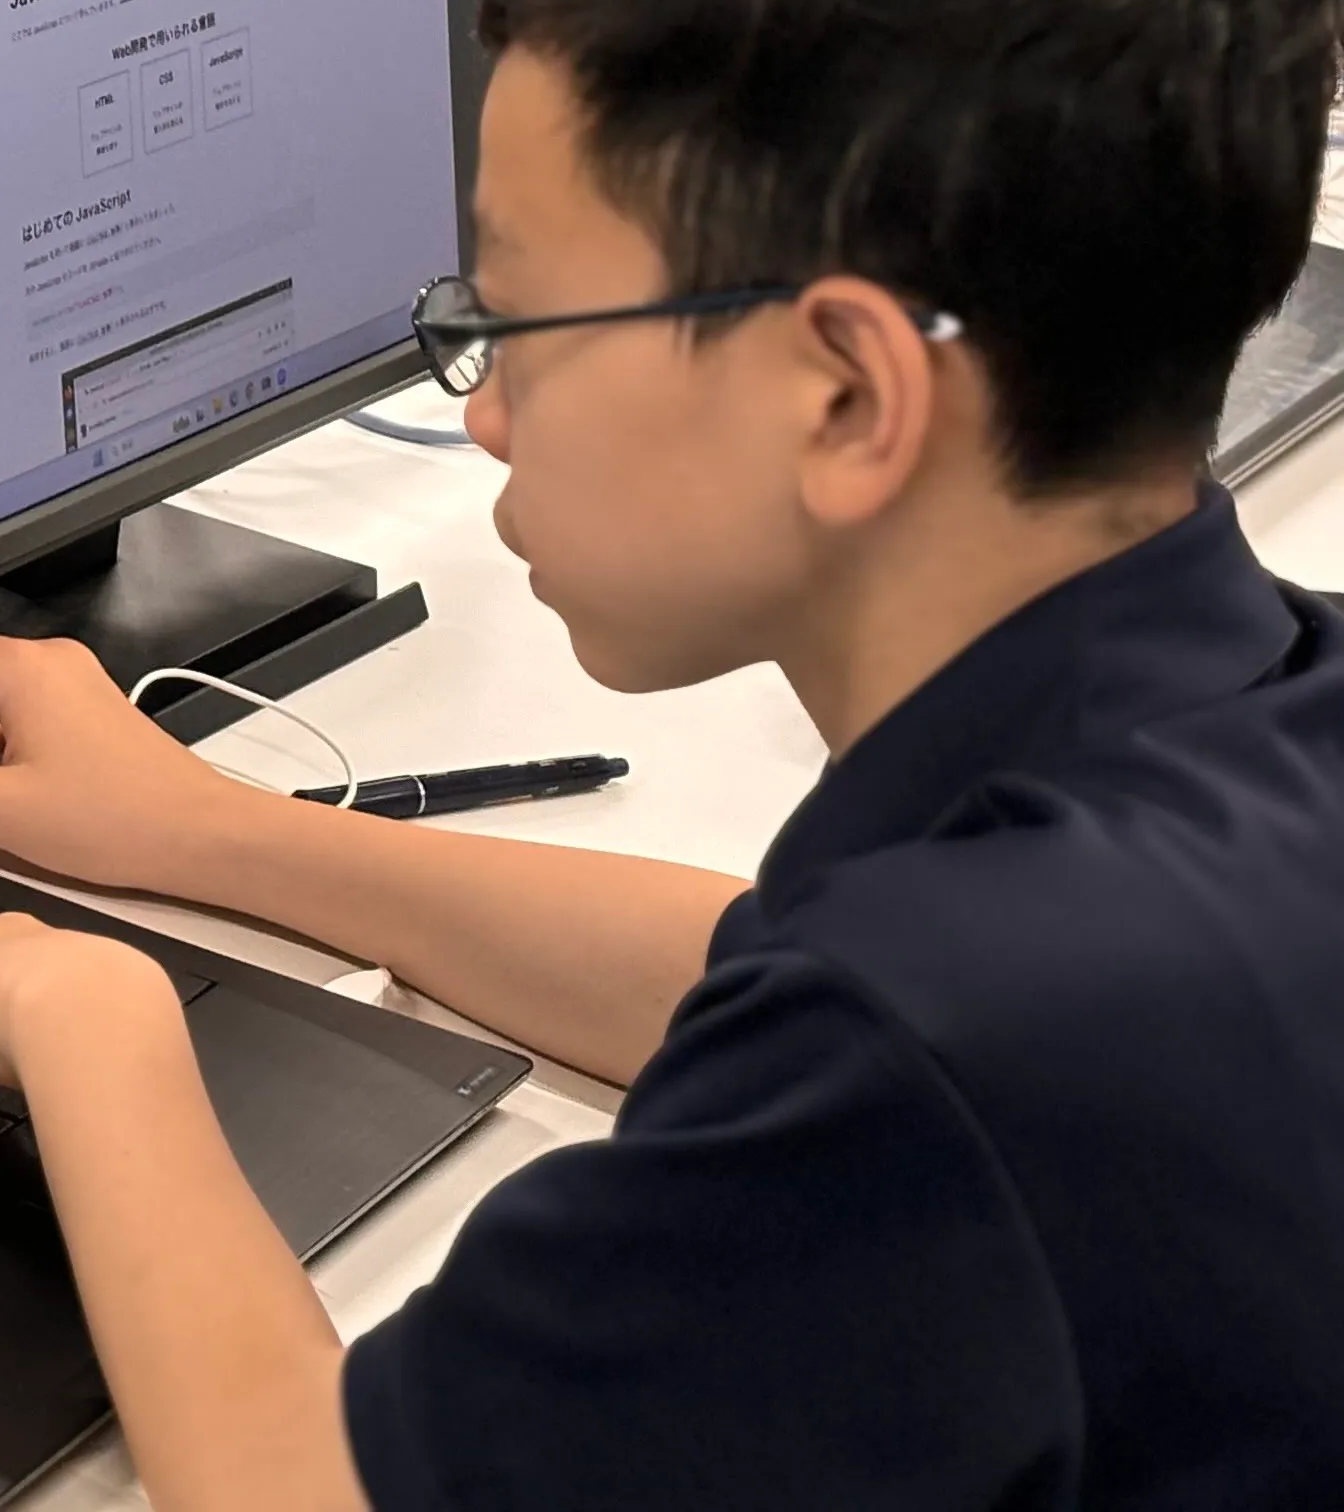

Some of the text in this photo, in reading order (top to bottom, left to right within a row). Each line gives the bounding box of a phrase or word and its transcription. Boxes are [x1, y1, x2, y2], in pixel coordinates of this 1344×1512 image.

[22, 210, 74, 244] はじめての
[76, 188, 132, 224] JavaScript
